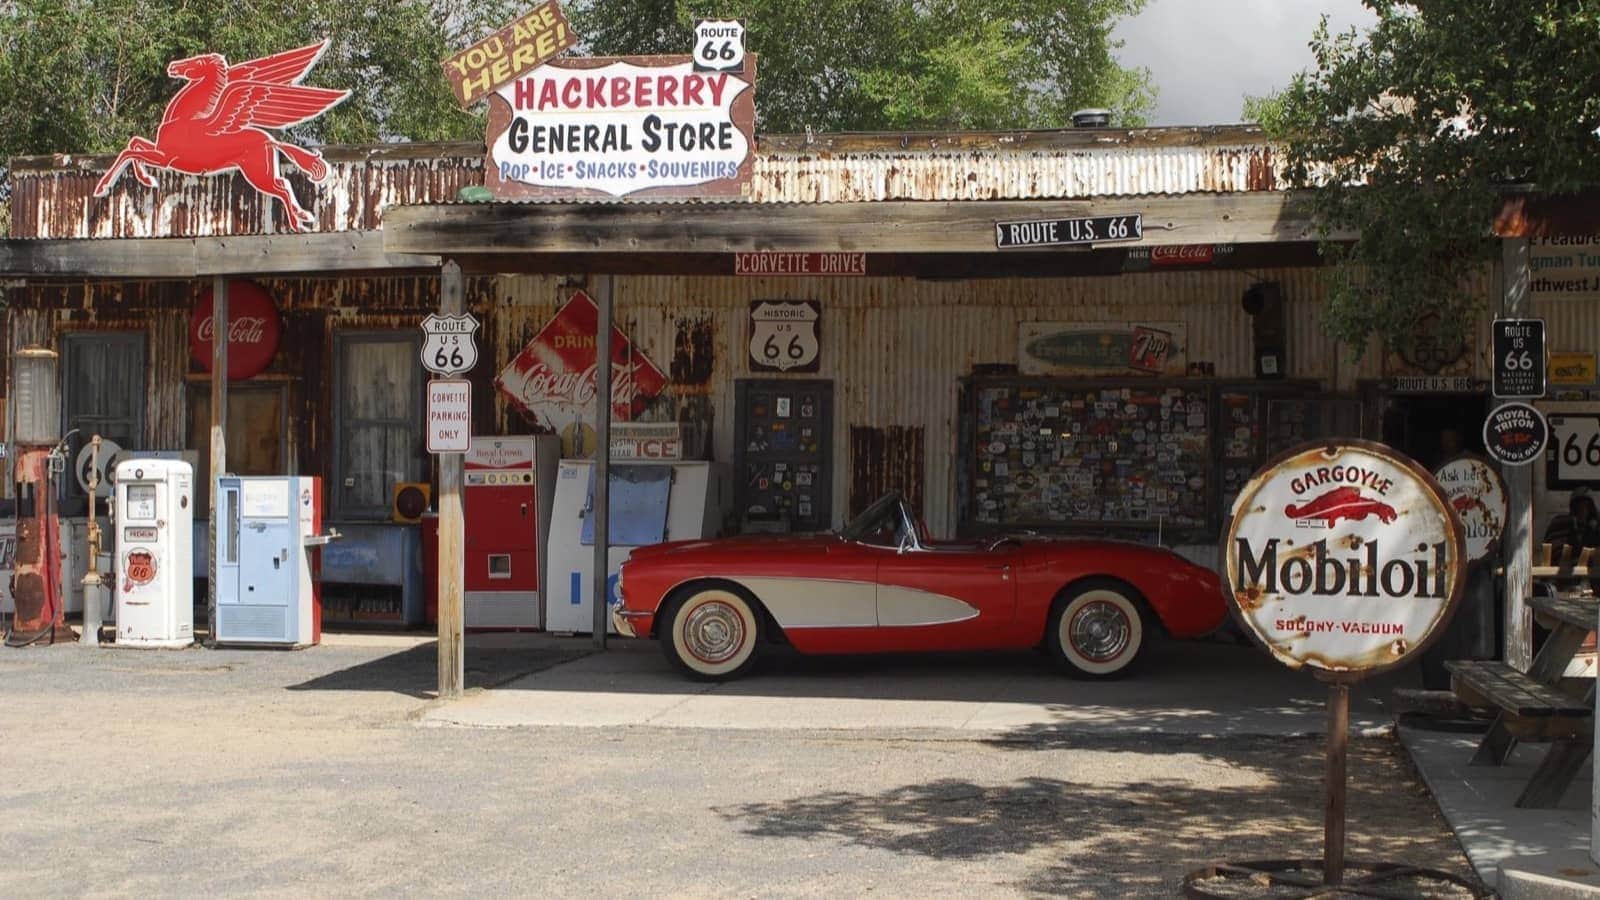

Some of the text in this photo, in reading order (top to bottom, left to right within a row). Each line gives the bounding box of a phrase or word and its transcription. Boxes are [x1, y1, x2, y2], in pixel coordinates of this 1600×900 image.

[452, 6, 558, 77] YOU ARE
[700, 27, 738, 38] ROUTE
[702, 40, 737, 61] 66
[462, 22, 566, 101] HERE!
[514, 72, 728, 111] HACKBERRY
[508, 114, 732, 153] GENERAL STORE
[1010, 218, 1128, 245] ROUTE U.S. 66
[741, 253, 860, 273] CORVETTE DRIVE
[763, 310, 805, 318] HISTORIC
[434, 321, 466, 331] ROUTE
[1504, 326, 1532, 337] ROUTE
[554, 335, 597, 350] DRIN
[764, 334, 804, 359] 66
[1513, 337, 1524, 349] US
[435, 347, 463, 368] 66
[1504, 350, 1533, 370] 66
[431, 392, 468, 403] CORVETTE
[431, 412, 468, 421] PARKING
[1494, 418, 1535, 433] TRITON
[1496, 409, 1531, 422] ROYAL
[439, 429, 459, 440] ONLY
[635, 437, 677, 457] ICE
[1563, 432, 1600, 466] 66
[1290, 465, 1394, 496] GARGOYLE
[1440, 468, 1459, 482] Ask
[132, 566, 148, 578] 66
[1236, 537, 1449, 600] Mobiloil
